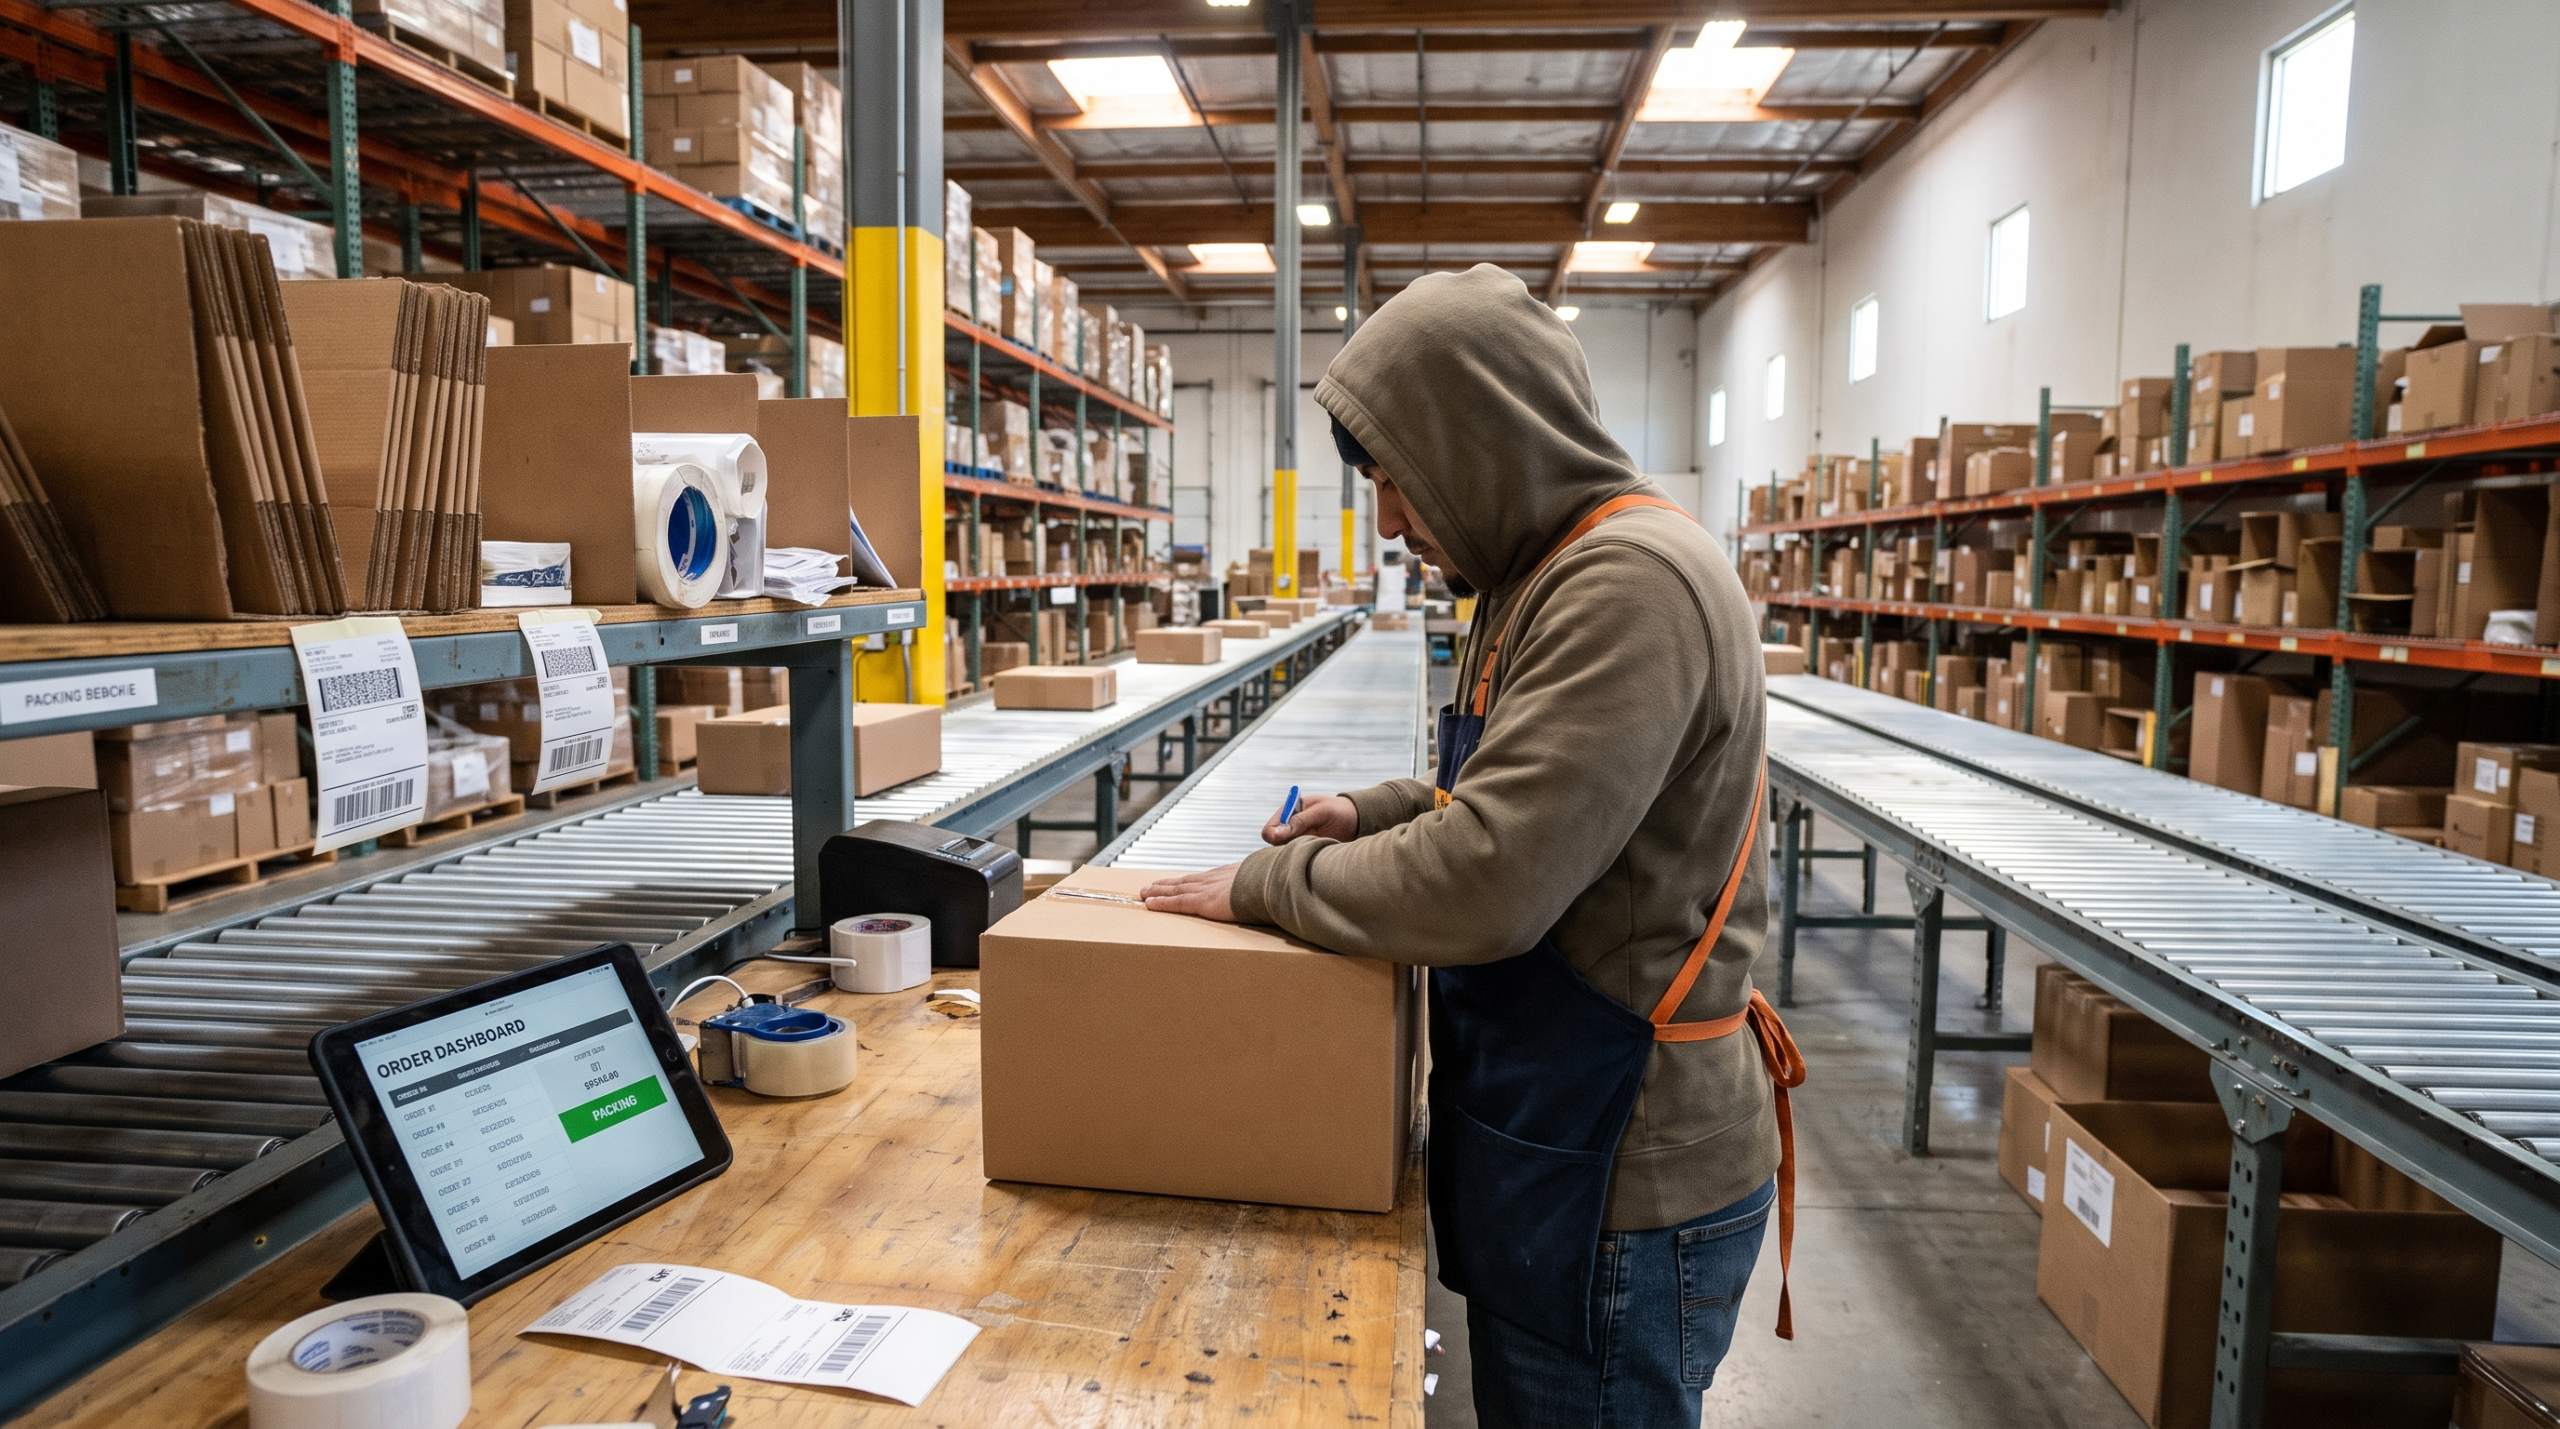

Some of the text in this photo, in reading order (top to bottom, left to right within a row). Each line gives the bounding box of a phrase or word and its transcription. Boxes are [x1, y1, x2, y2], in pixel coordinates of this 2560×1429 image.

[25, 688, 82, 708] PACKING
[377, 1049, 434, 1079] ORDER
[434, 1019, 526, 1060] DASHBOARD
[592, 1095, 638, 1121] PACKING
